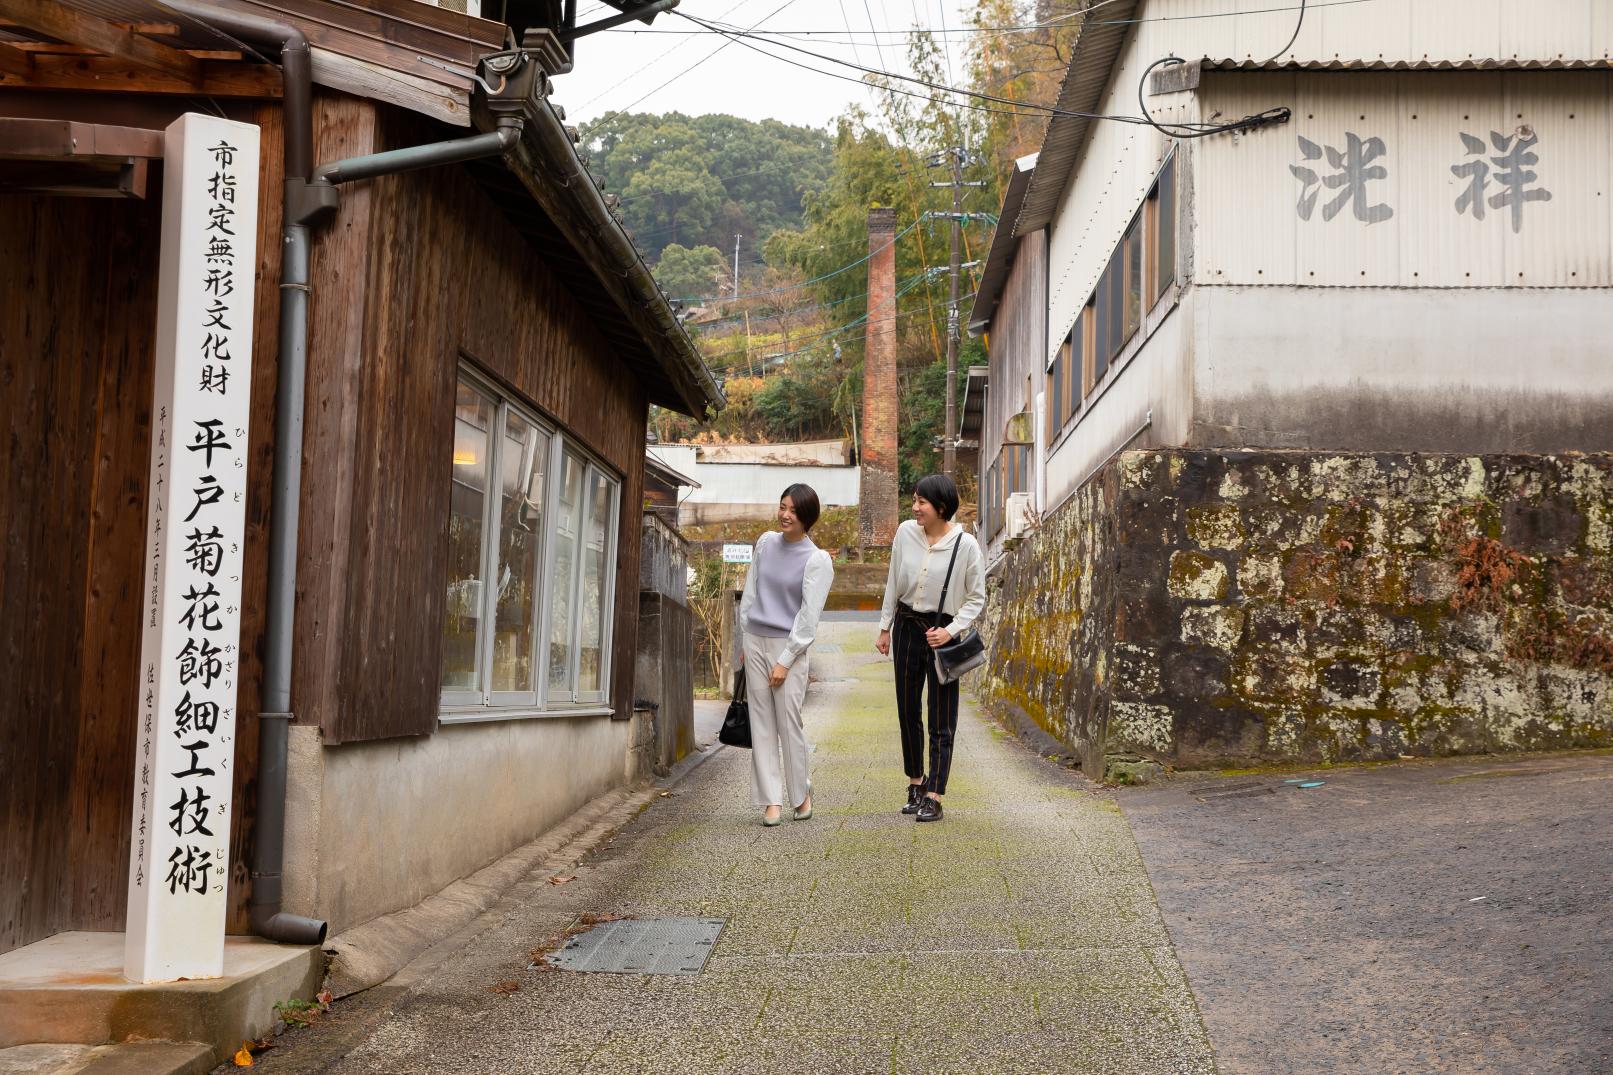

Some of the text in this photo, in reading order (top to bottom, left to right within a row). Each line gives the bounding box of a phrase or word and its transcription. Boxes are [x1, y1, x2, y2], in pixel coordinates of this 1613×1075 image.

[165, 140, 238, 896] 市指定無形文化財 平戸菊花飾細工技術
